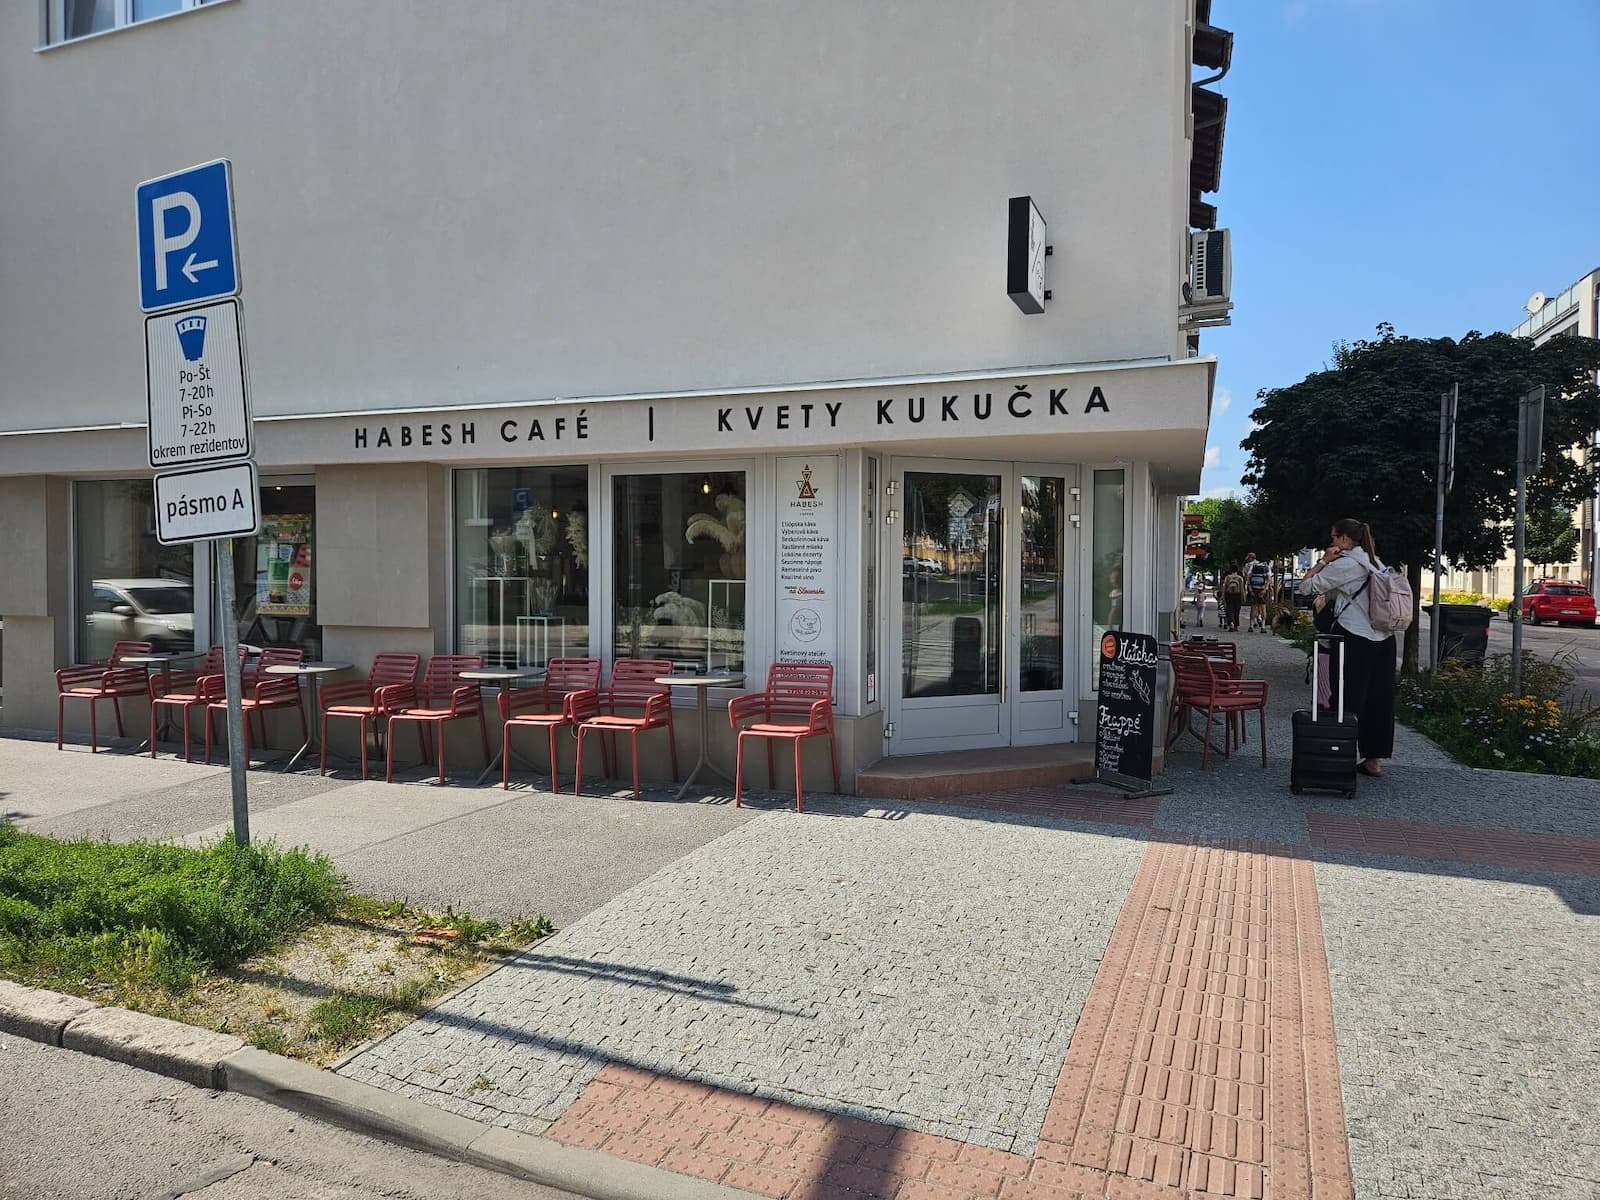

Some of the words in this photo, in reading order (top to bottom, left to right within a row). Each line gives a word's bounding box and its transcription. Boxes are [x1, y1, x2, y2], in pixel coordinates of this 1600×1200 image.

[152, 191, 201, 290] P
[180, 364, 211, 384] Po-Št
[182, 404, 212, 419] Pi-So
[355, 422, 475, 448] HABESH
[500, 409, 589, 442] CAFÉ
[717, 402, 842, 432] KVETY
[877, 385, 1110, 424] KUKUČKA
[153, 445, 186, 459] okrem
[190, 437, 245, 455] rezidentov
[167, 494, 227, 523] pásmo
[232, 488, 244, 510] A
